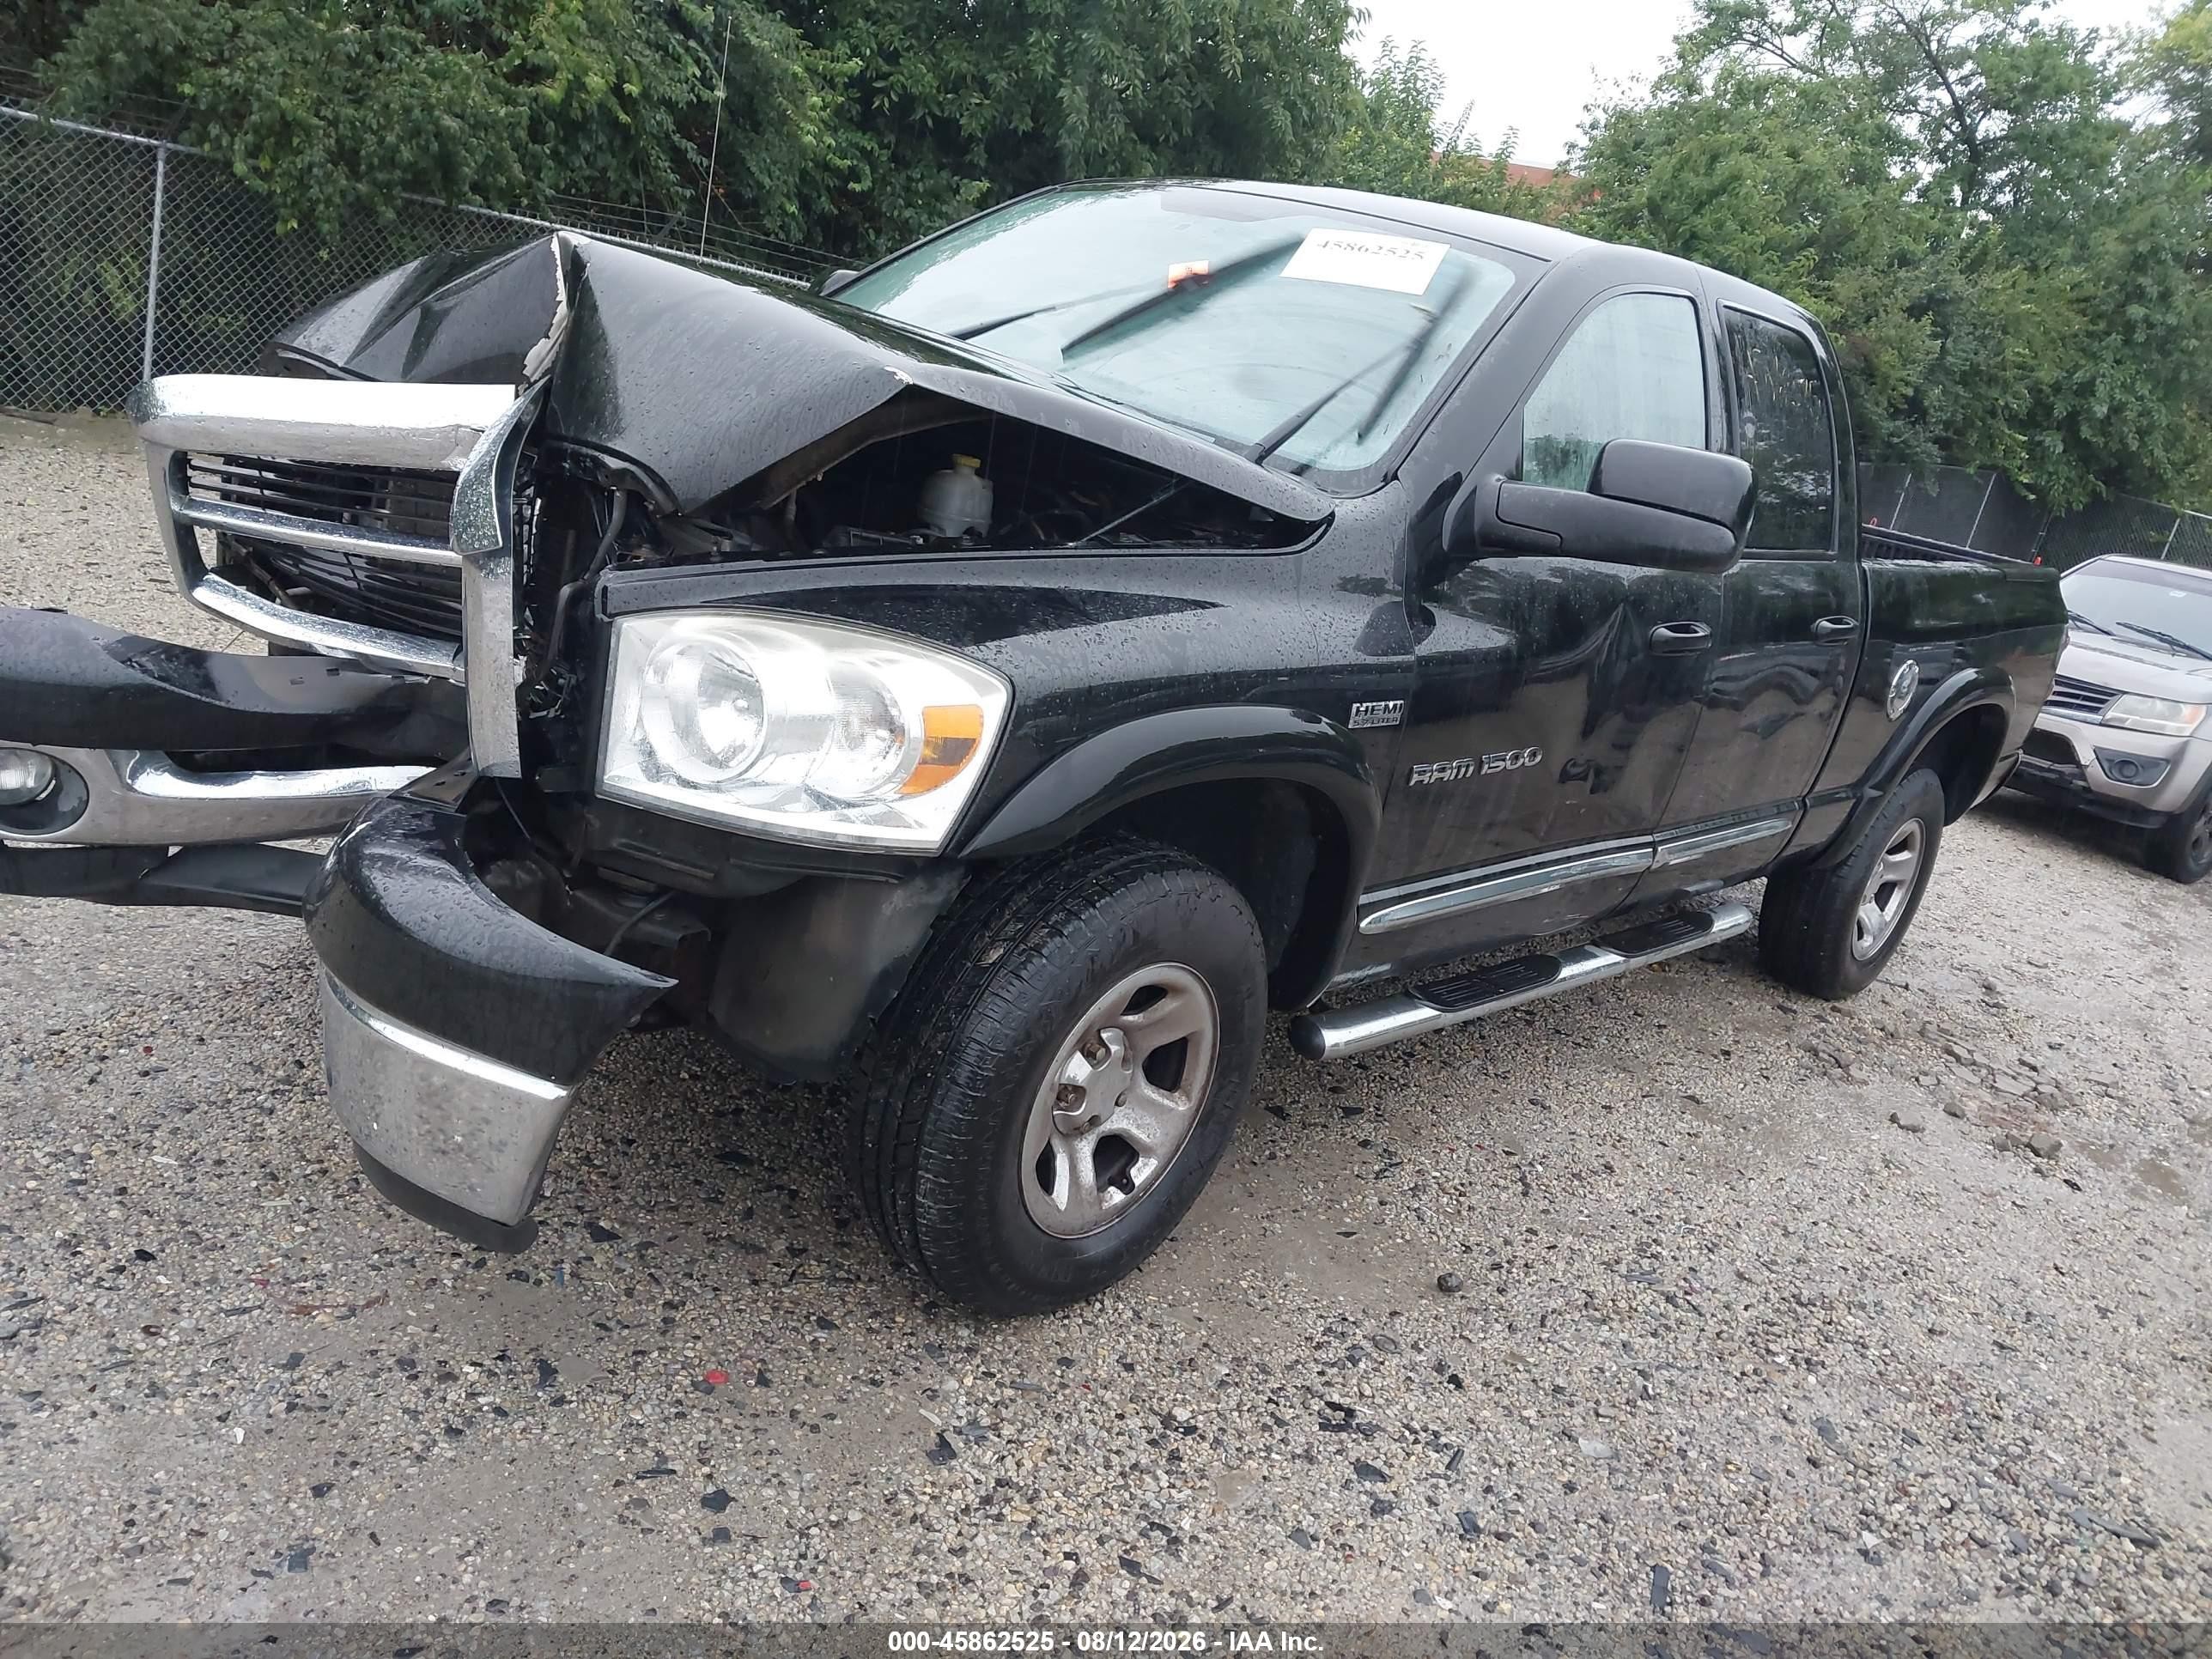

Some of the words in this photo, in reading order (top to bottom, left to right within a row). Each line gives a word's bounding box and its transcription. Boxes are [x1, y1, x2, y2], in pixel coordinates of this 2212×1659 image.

[1317, 240, 1425, 260] 45862525
[1354, 702, 1403, 716] HEMI
[1352, 717, 1370, 726] 5.7
[1371, 716, 1399, 725] LITER
[1409, 758, 1475, 787] RAM
[1480, 746, 1543, 775] 1500
